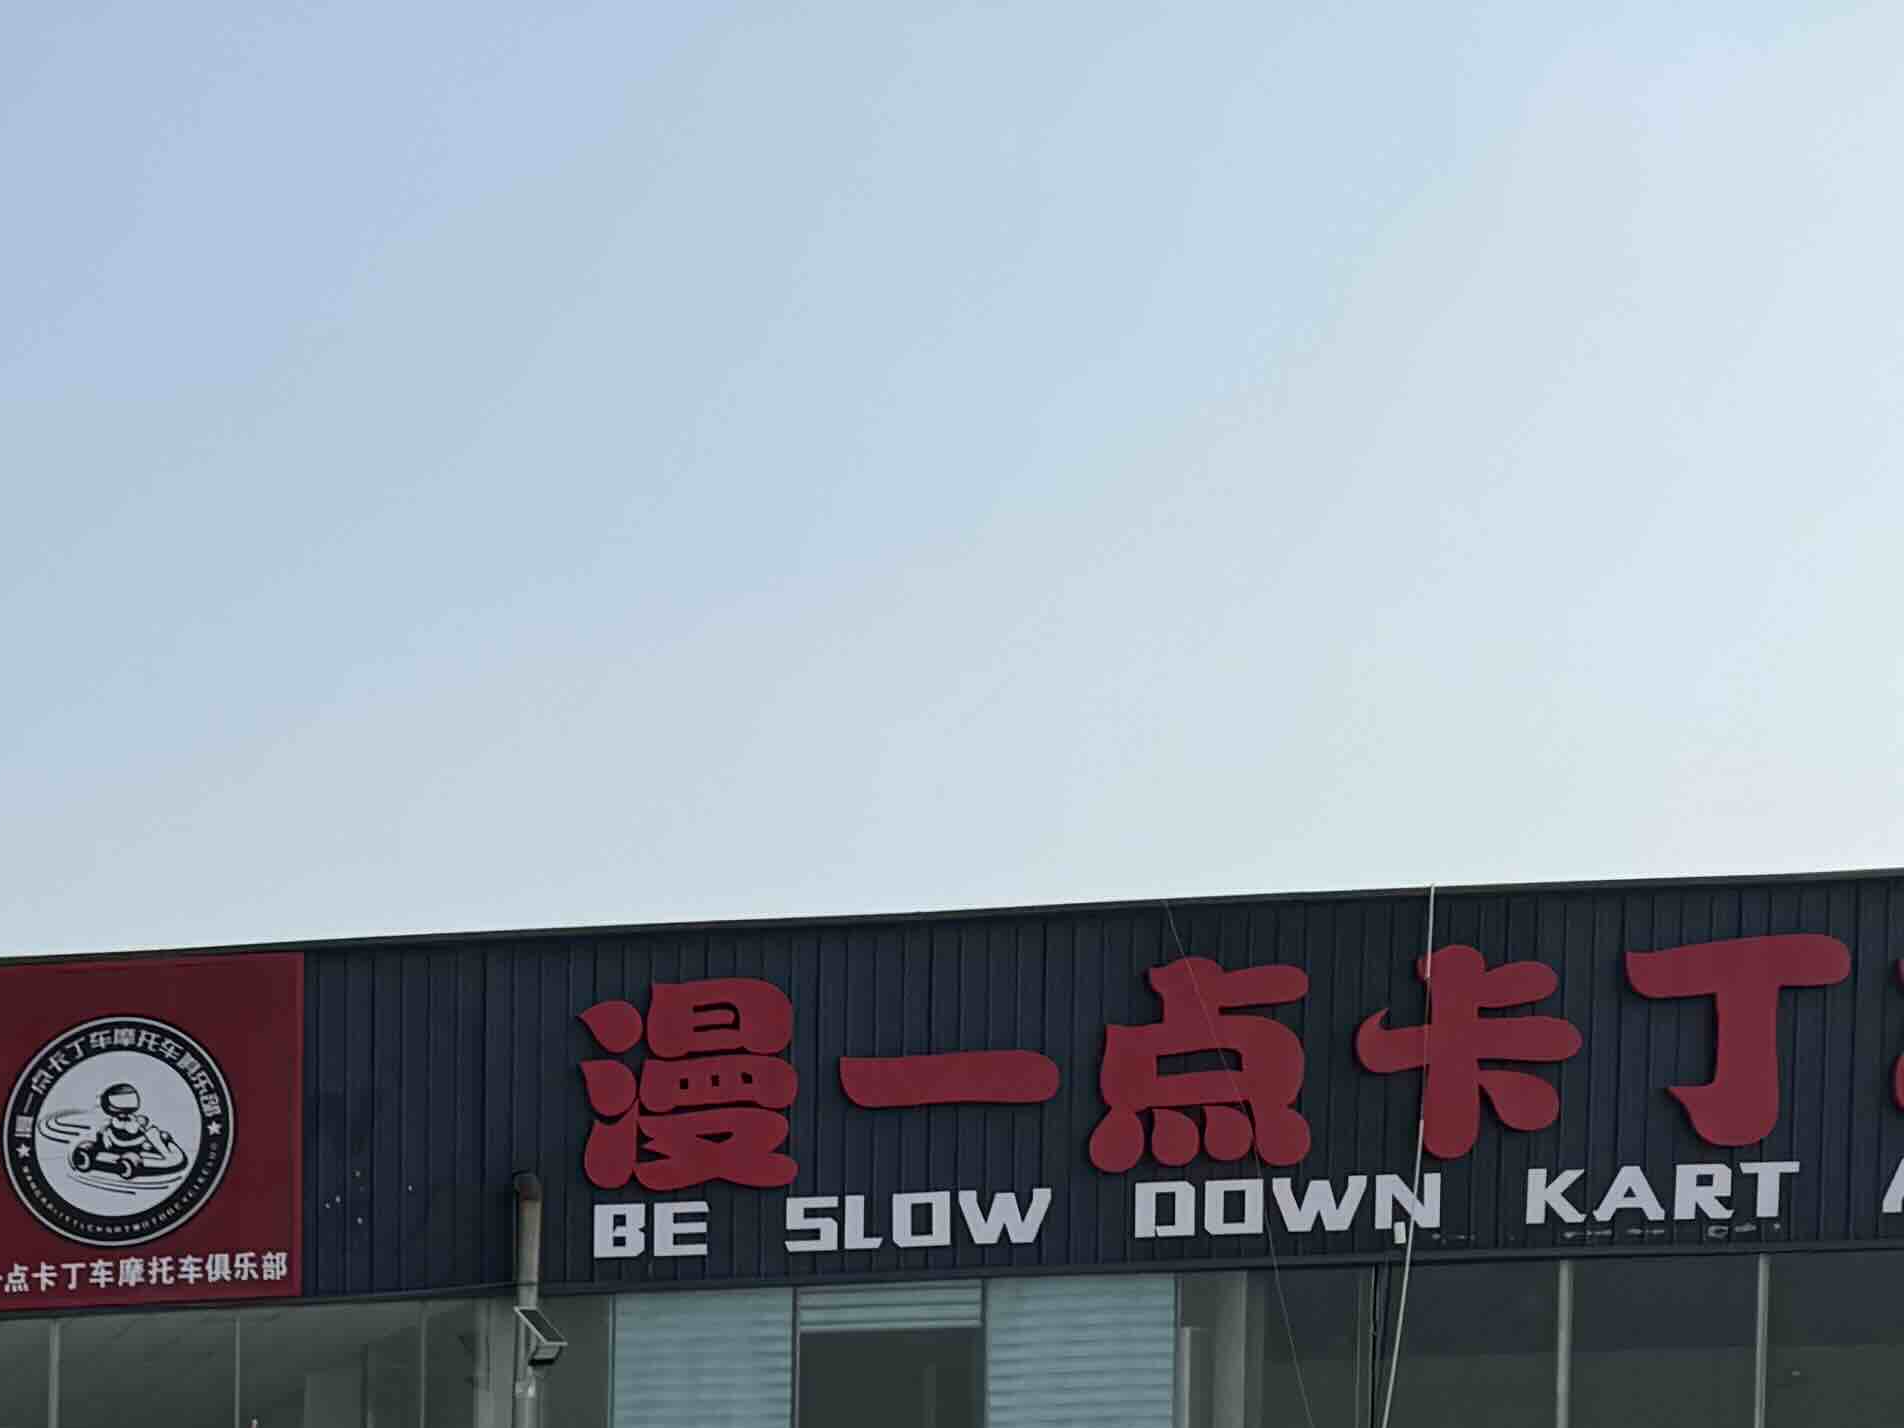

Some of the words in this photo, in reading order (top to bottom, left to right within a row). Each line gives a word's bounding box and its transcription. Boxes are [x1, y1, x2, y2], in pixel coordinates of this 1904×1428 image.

[581, 933, 1904, 1190] 漫一点卡丁
[593, 1201, 710, 1258] BE
[784, 1187, 1052, 1253] SLOW
[1134, 1172, 1442, 1238] DOWN
[1525, 1161, 1800, 1224] KART
